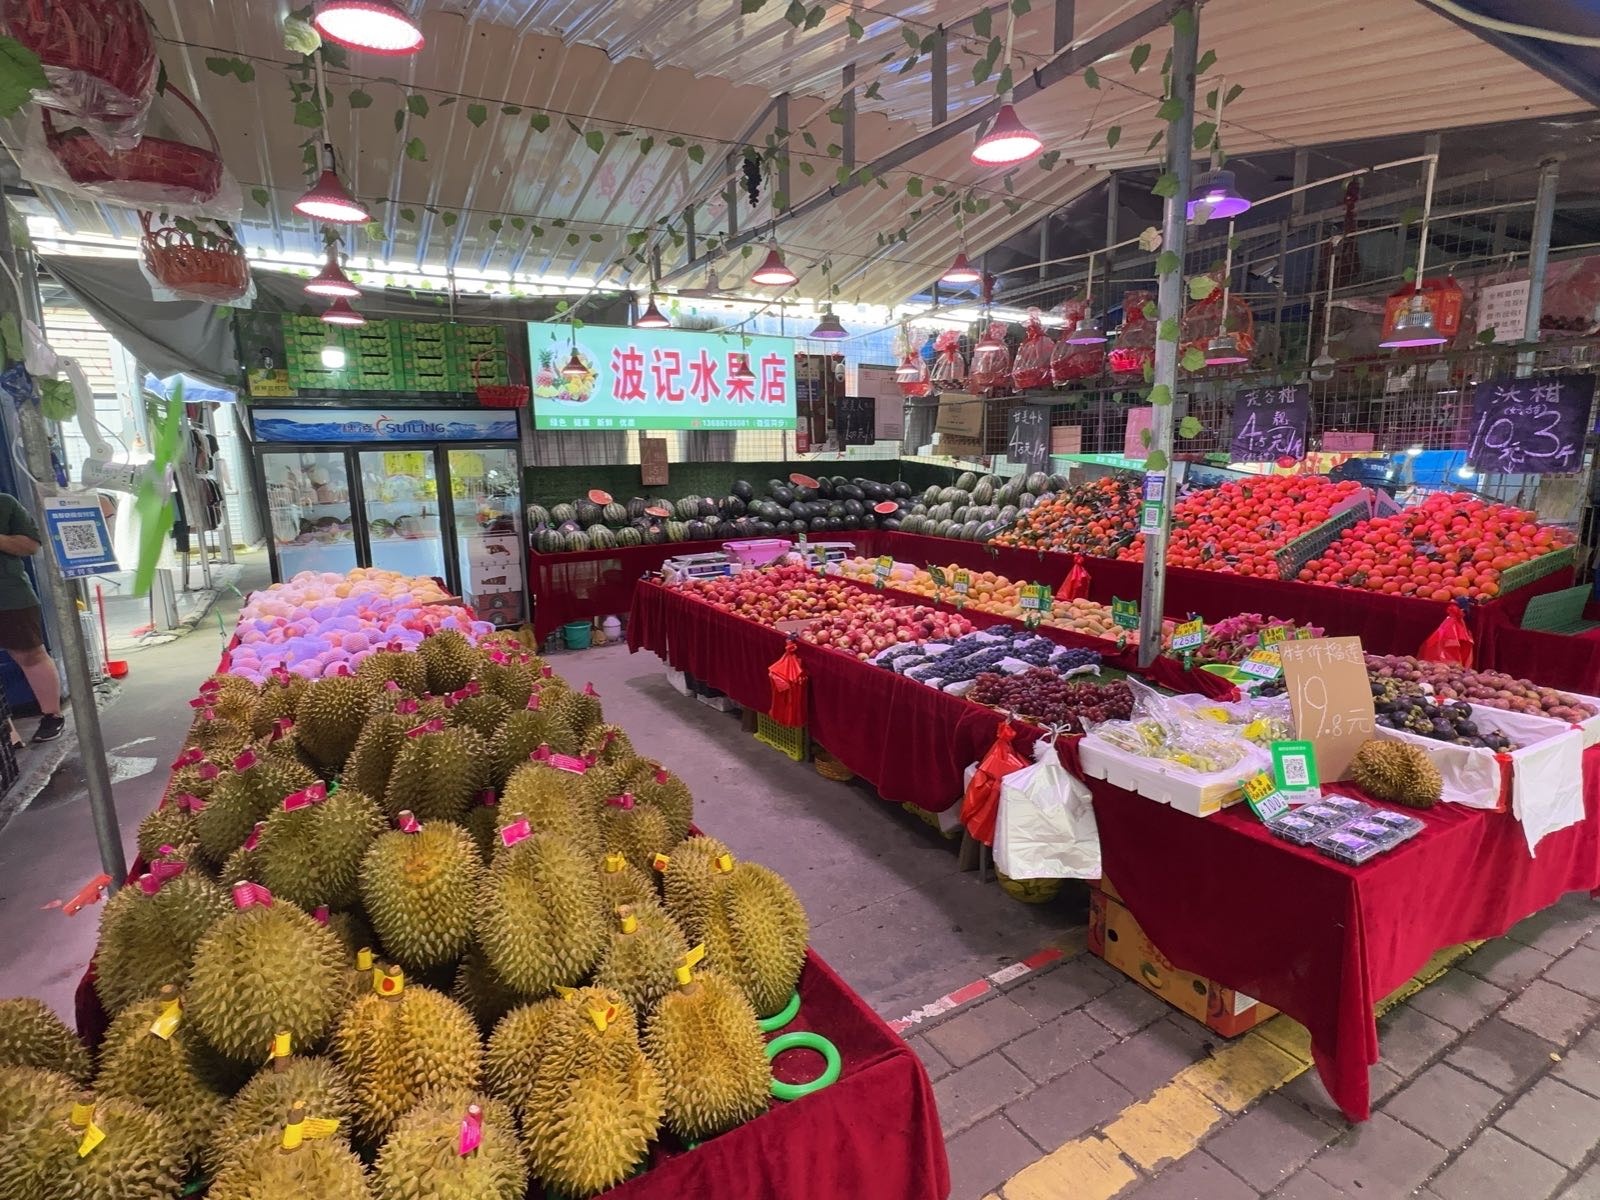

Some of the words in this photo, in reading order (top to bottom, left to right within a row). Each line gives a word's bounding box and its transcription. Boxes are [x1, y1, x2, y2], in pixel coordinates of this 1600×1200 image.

[610, 346, 786, 404] 波记水果店
[386, 423, 445, 433] SUILING
[1283, 641, 1366, 669] 特价榴莲
